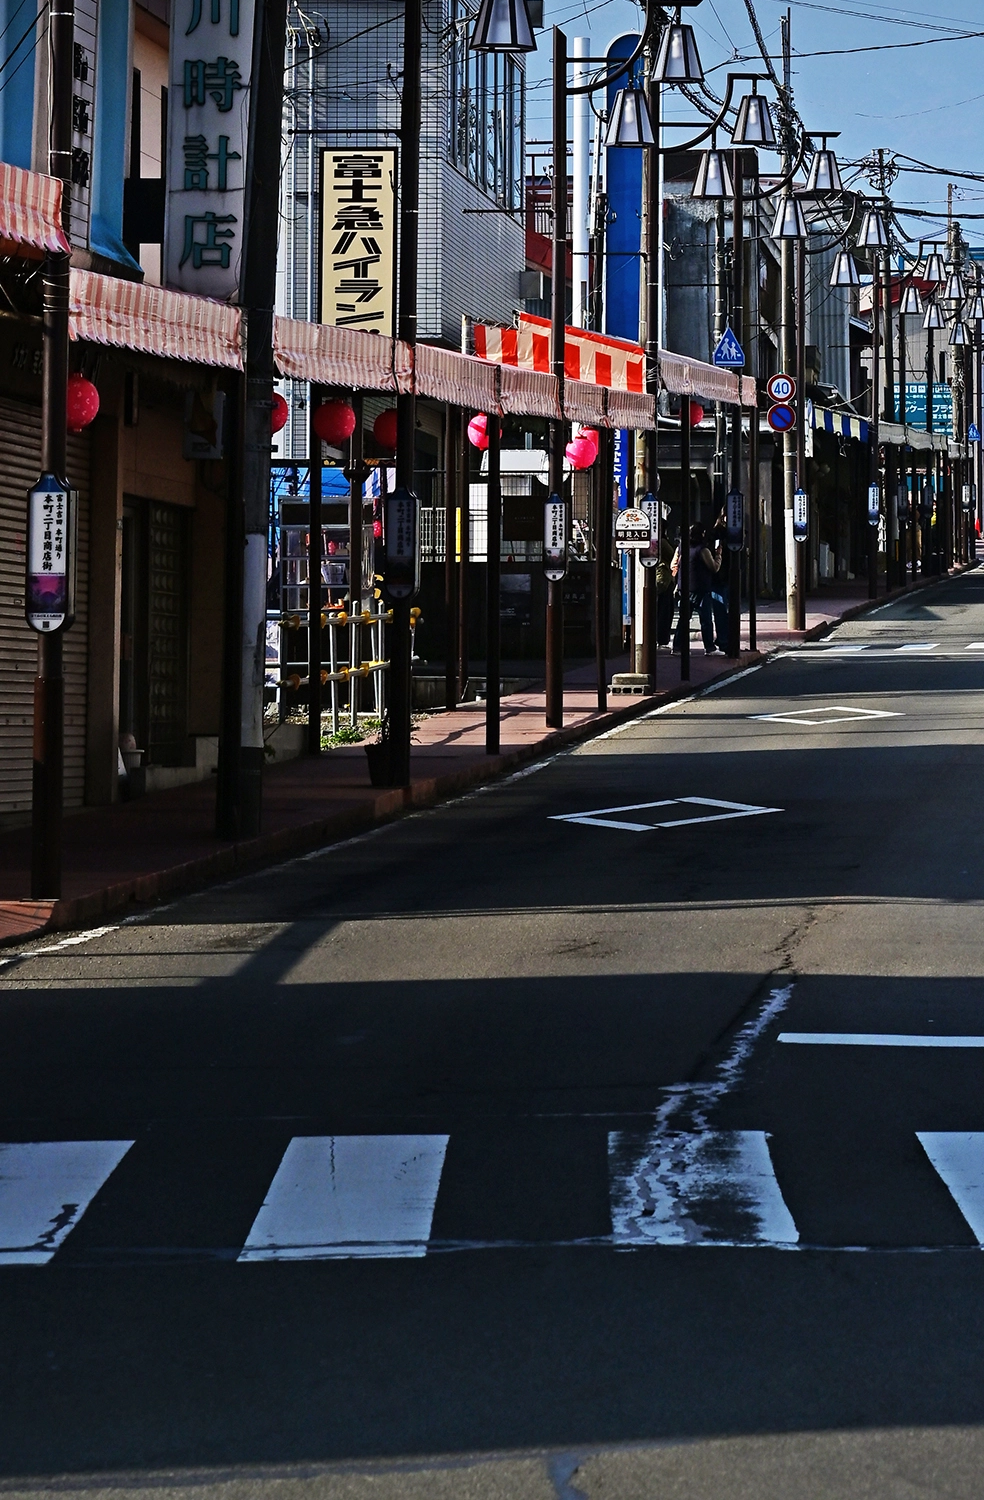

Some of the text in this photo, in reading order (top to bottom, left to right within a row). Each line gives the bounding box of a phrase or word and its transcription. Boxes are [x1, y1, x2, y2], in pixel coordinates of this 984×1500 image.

[331, 154, 386, 335] 富士急ハイラン
[773, 382, 790, 395] 40
[42, 493, 54, 571] 本町二丁目商店街
[55, 493, 64, 560] 富士吉田 本町通り
[617, 530, 648, 539] 明見入口
